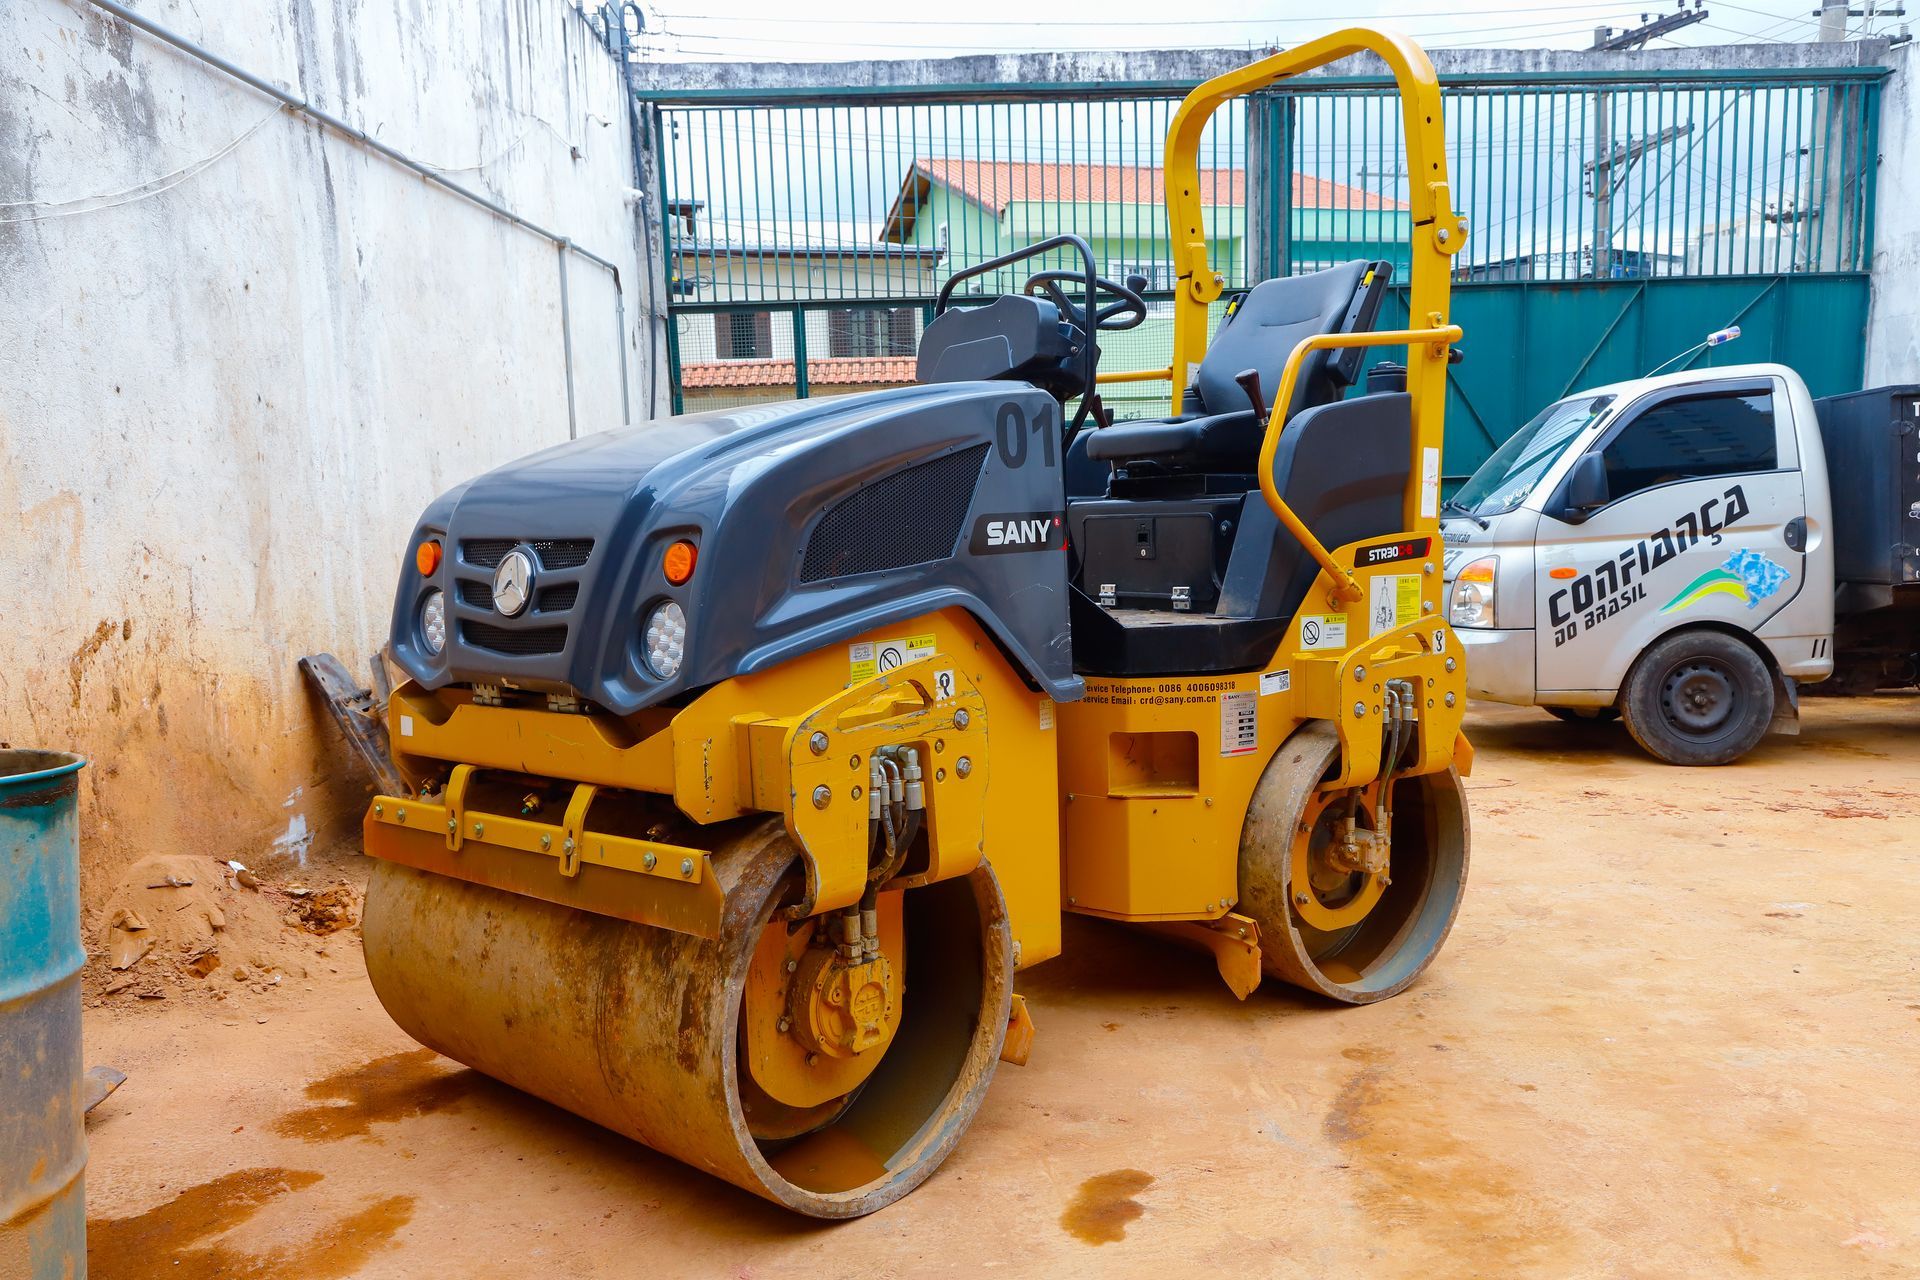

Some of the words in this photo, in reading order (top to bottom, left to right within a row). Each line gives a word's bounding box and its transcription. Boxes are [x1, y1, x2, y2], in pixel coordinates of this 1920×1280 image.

[996, 402, 1056, 469] 01
[986, 519, 1051, 546] SANY
[1554, 621, 1578, 648] DO
[1584, 582, 1647, 630] BRASIL
[1086, 684, 1108, 693] ervice
[1158, 684, 1182, 693] 0086
[1186, 681, 1236, 692] 4006098318
[1140, 695, 1217, 706] crd@sany.com.cn
